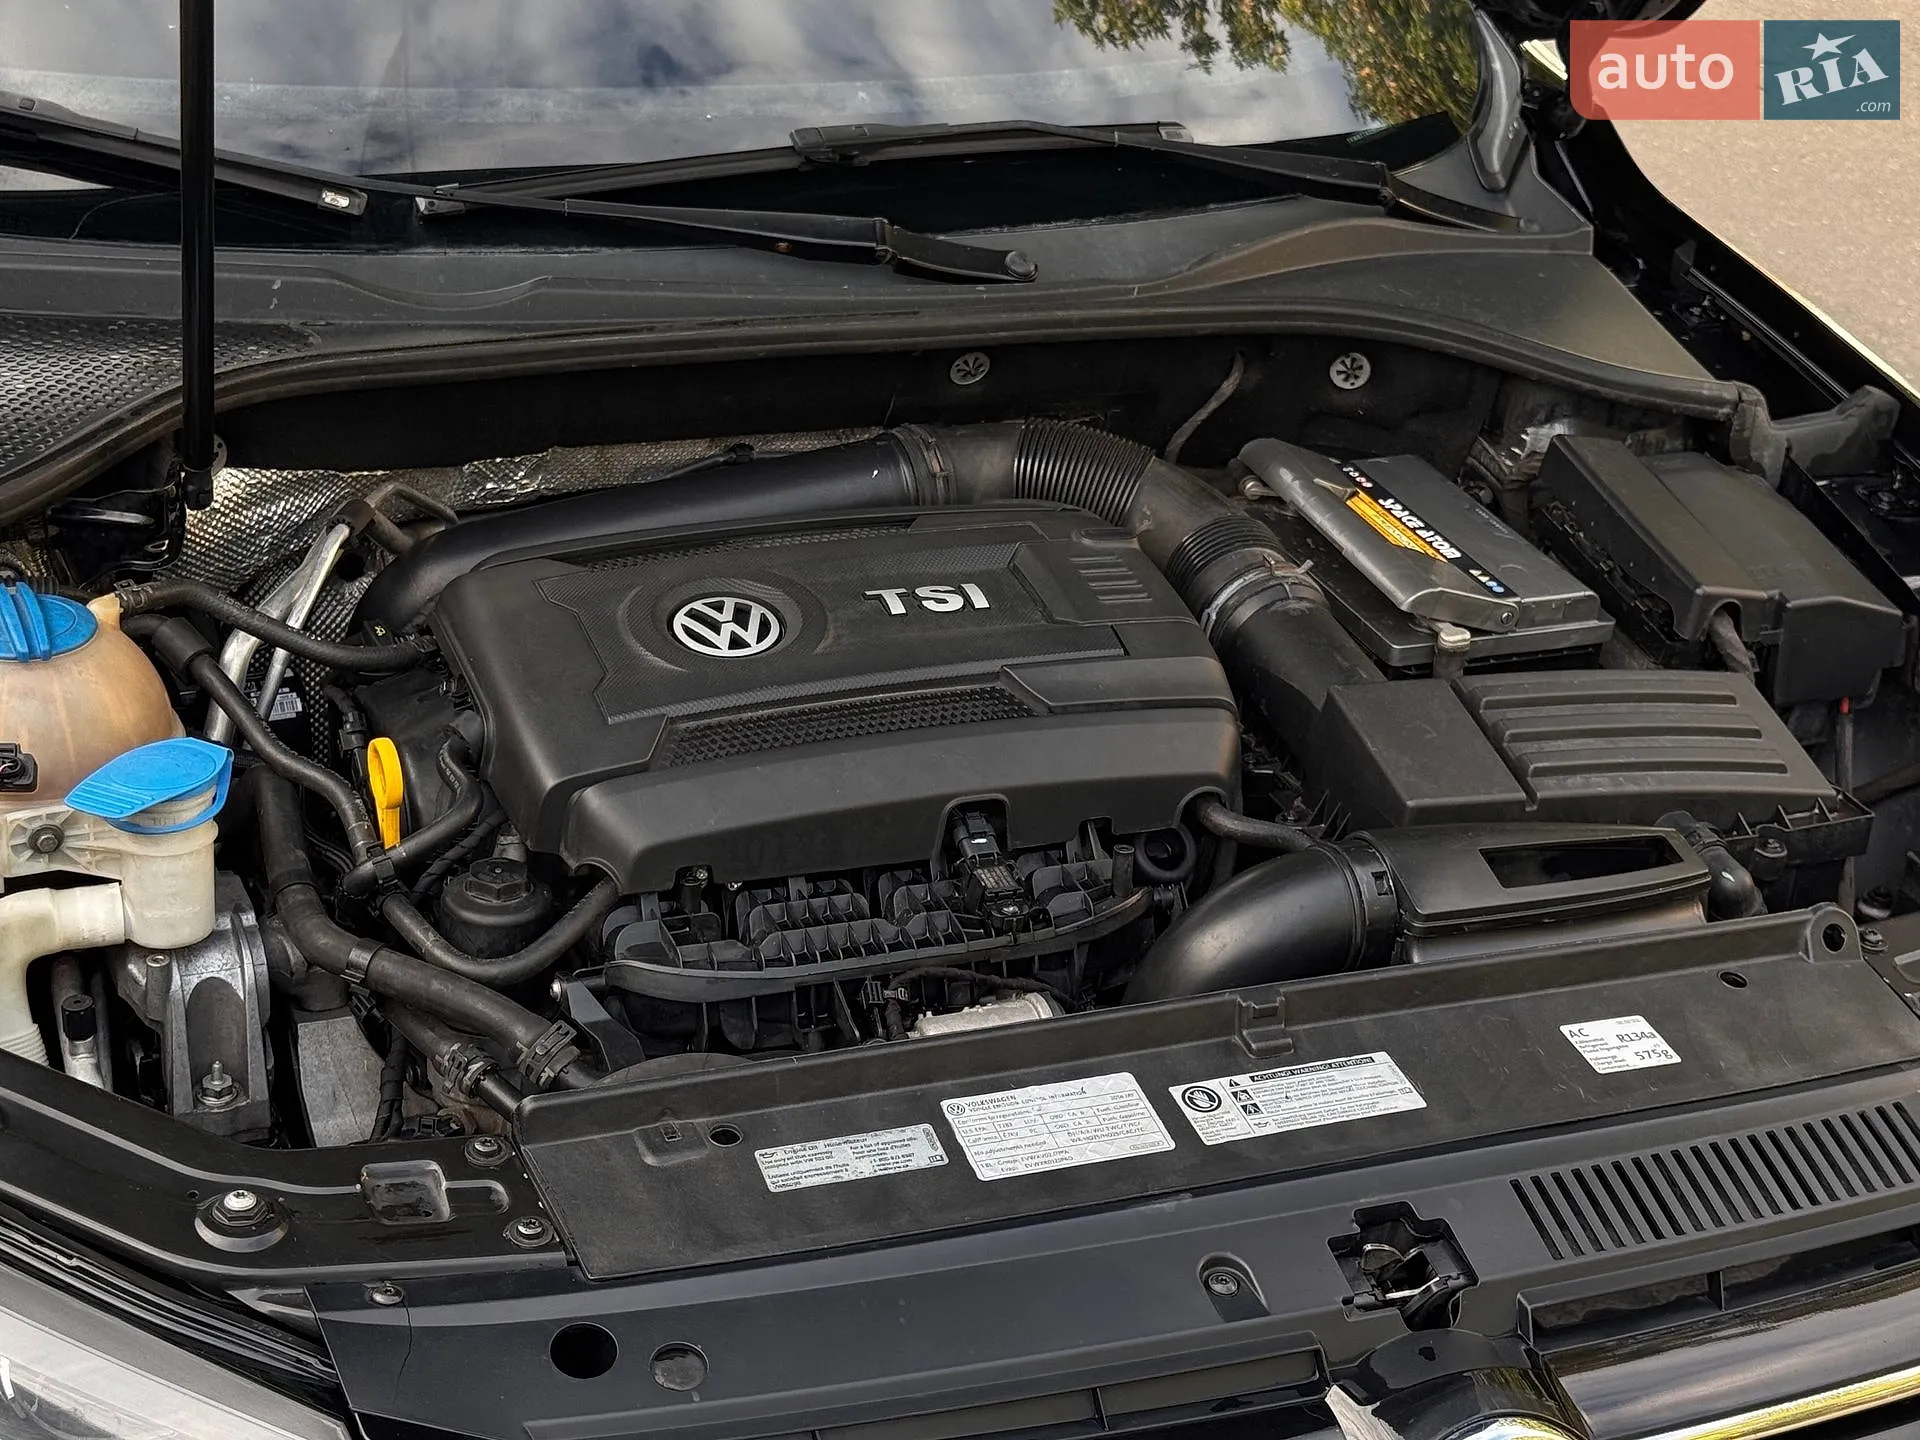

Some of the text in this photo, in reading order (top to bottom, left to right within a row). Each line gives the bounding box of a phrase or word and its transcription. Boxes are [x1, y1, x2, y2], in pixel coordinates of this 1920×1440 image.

[864, 584, 990, 615] TSI
[1568, 1028, 1589, 1038] AC
[1616, 1031, 1657, 1043] R134a
[965, 1095, 1017, 1107] VOLKSWAGEN
